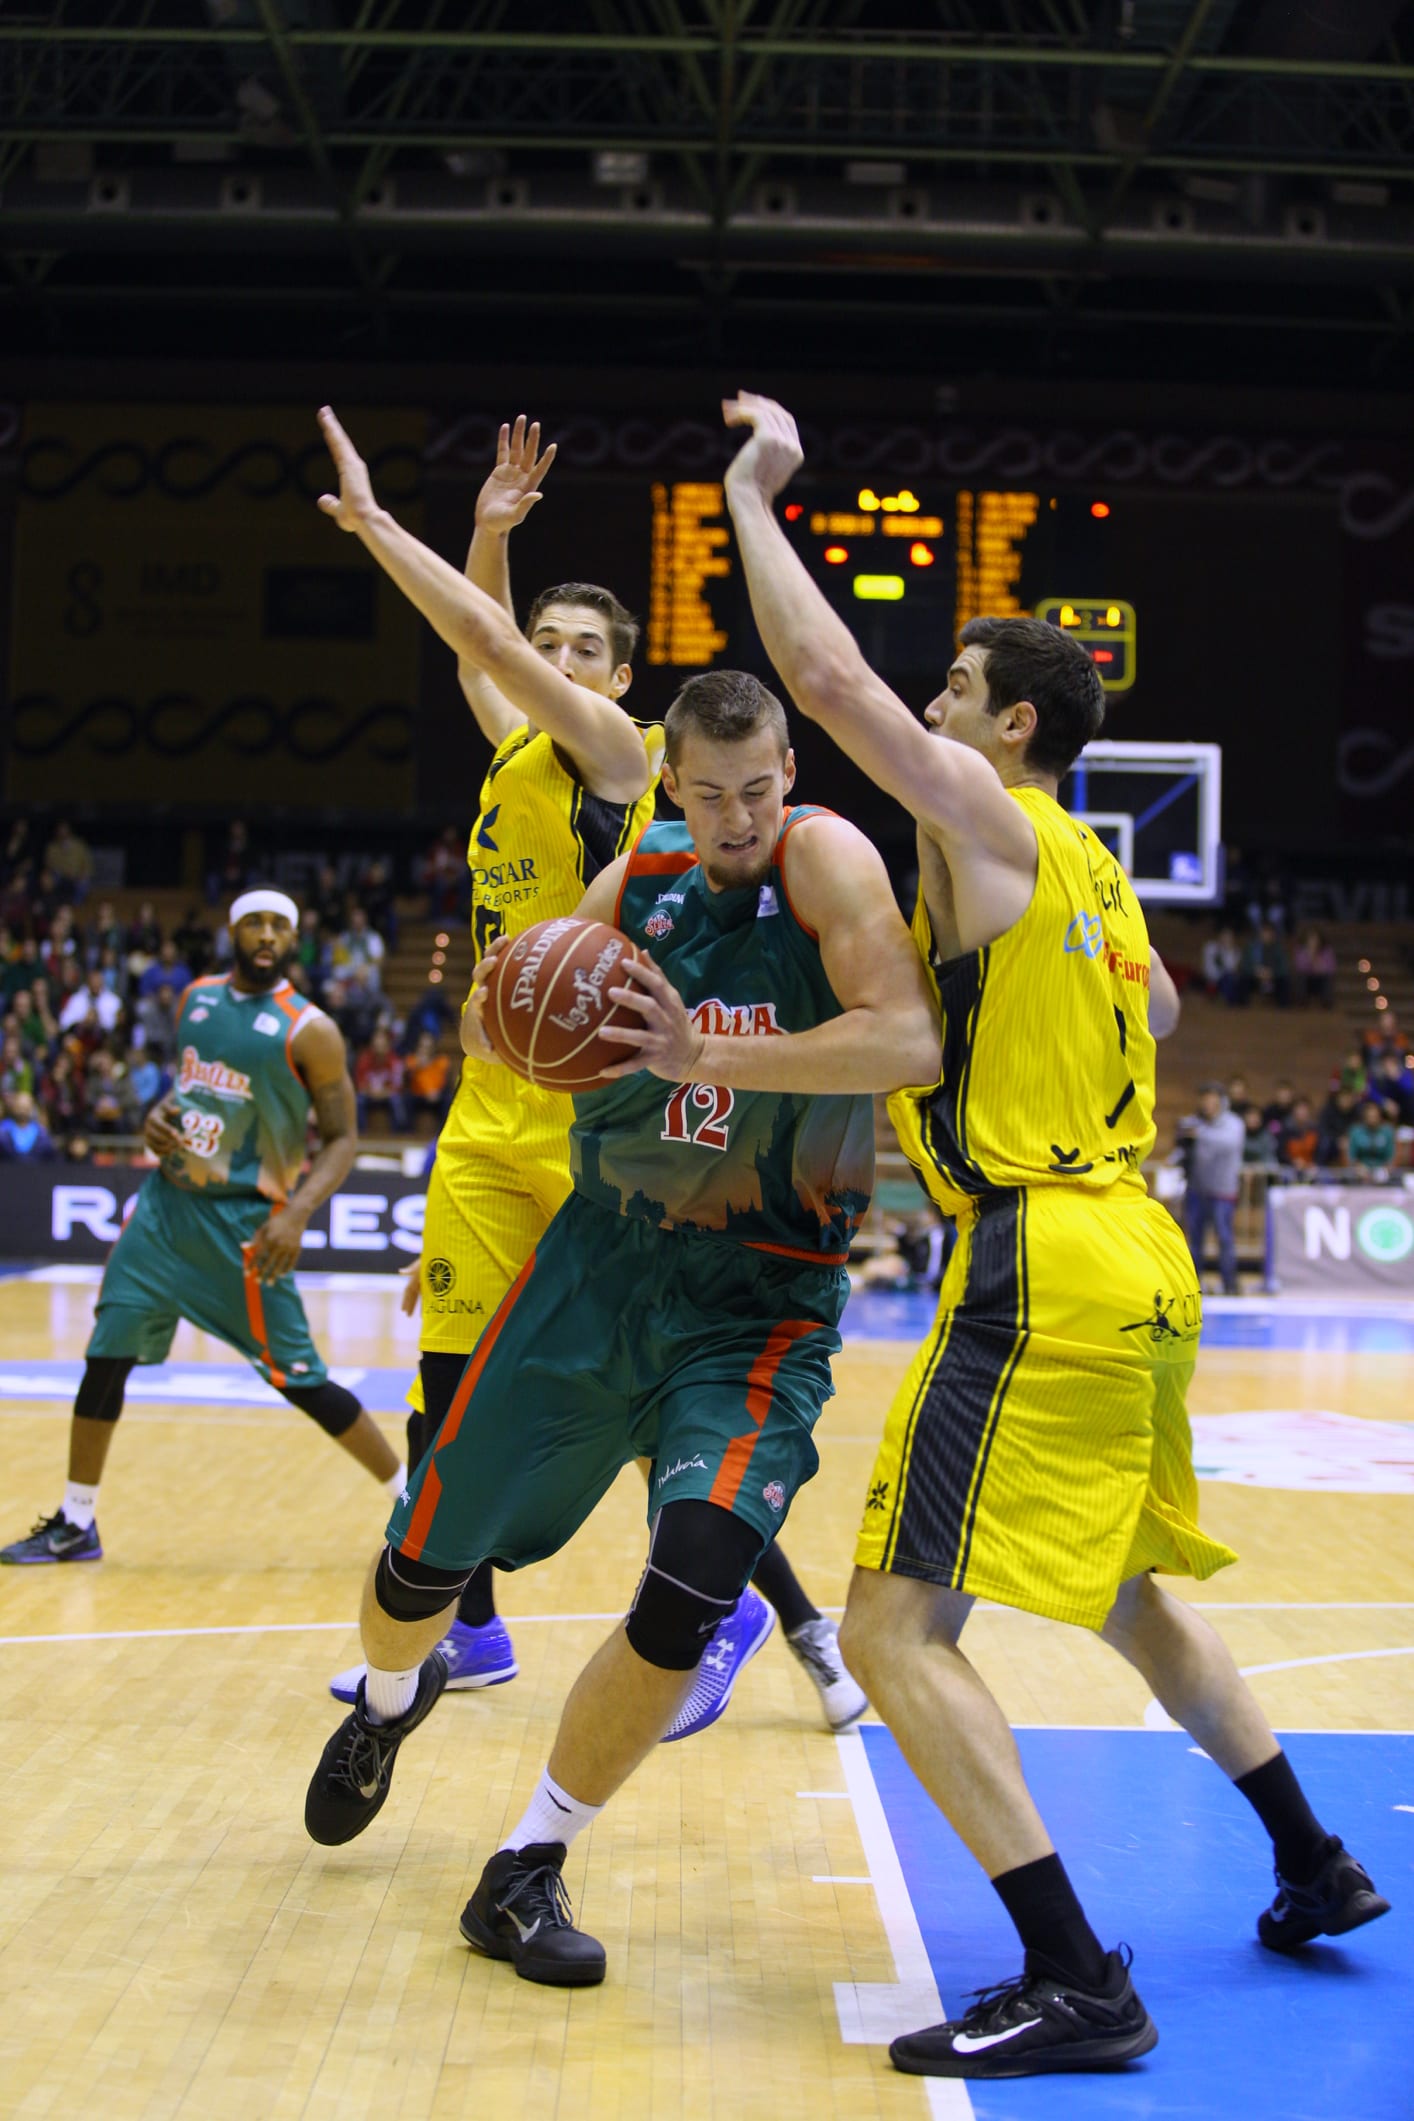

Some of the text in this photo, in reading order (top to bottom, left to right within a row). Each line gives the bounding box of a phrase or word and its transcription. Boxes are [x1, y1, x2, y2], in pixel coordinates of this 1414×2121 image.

[510, 918, 588, 1013] SPALDING
[181, 1109, 225, 1158] 23
[660, 1082, 734, 1152] 12
